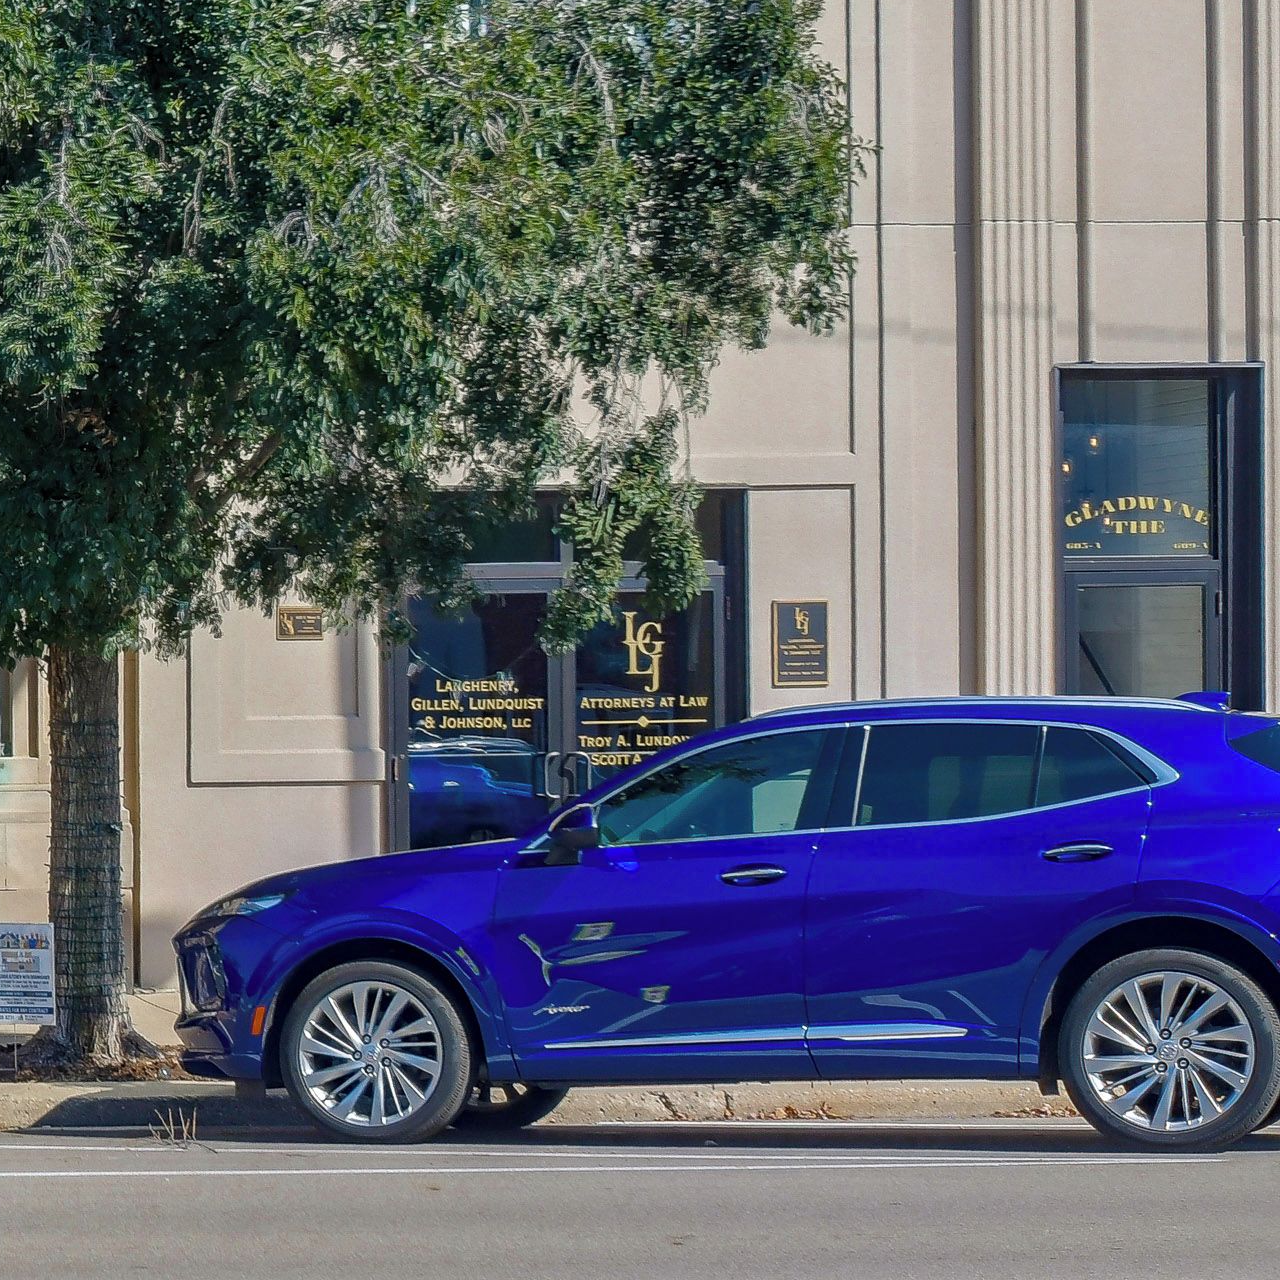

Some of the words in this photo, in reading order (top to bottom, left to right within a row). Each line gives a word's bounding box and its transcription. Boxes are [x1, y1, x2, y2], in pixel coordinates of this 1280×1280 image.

[1064, 496, 1209, 527] GLADWYNE
[1110, 520, 1166, 534] THE
[435, 679, 520, 694] LANGHENRY,
[411, 697, 465, 713] GILLEN,
[468, 697, 545, 711] LUNDQUIST
[580, 697, 655, 709] ATTORNEYS
[659, 697, 676, 708] AT
[679, 695, 709, 707] LAW
[424, 716, 436, 729] &
[438, 716, 508, 730] JOHNSON,
[578, 735, 613, 748] TROY
[616, 735, 631, 747] A.
[636, 734, 692, 747] LUND
[591, 753, 632, 766] SCOTT
